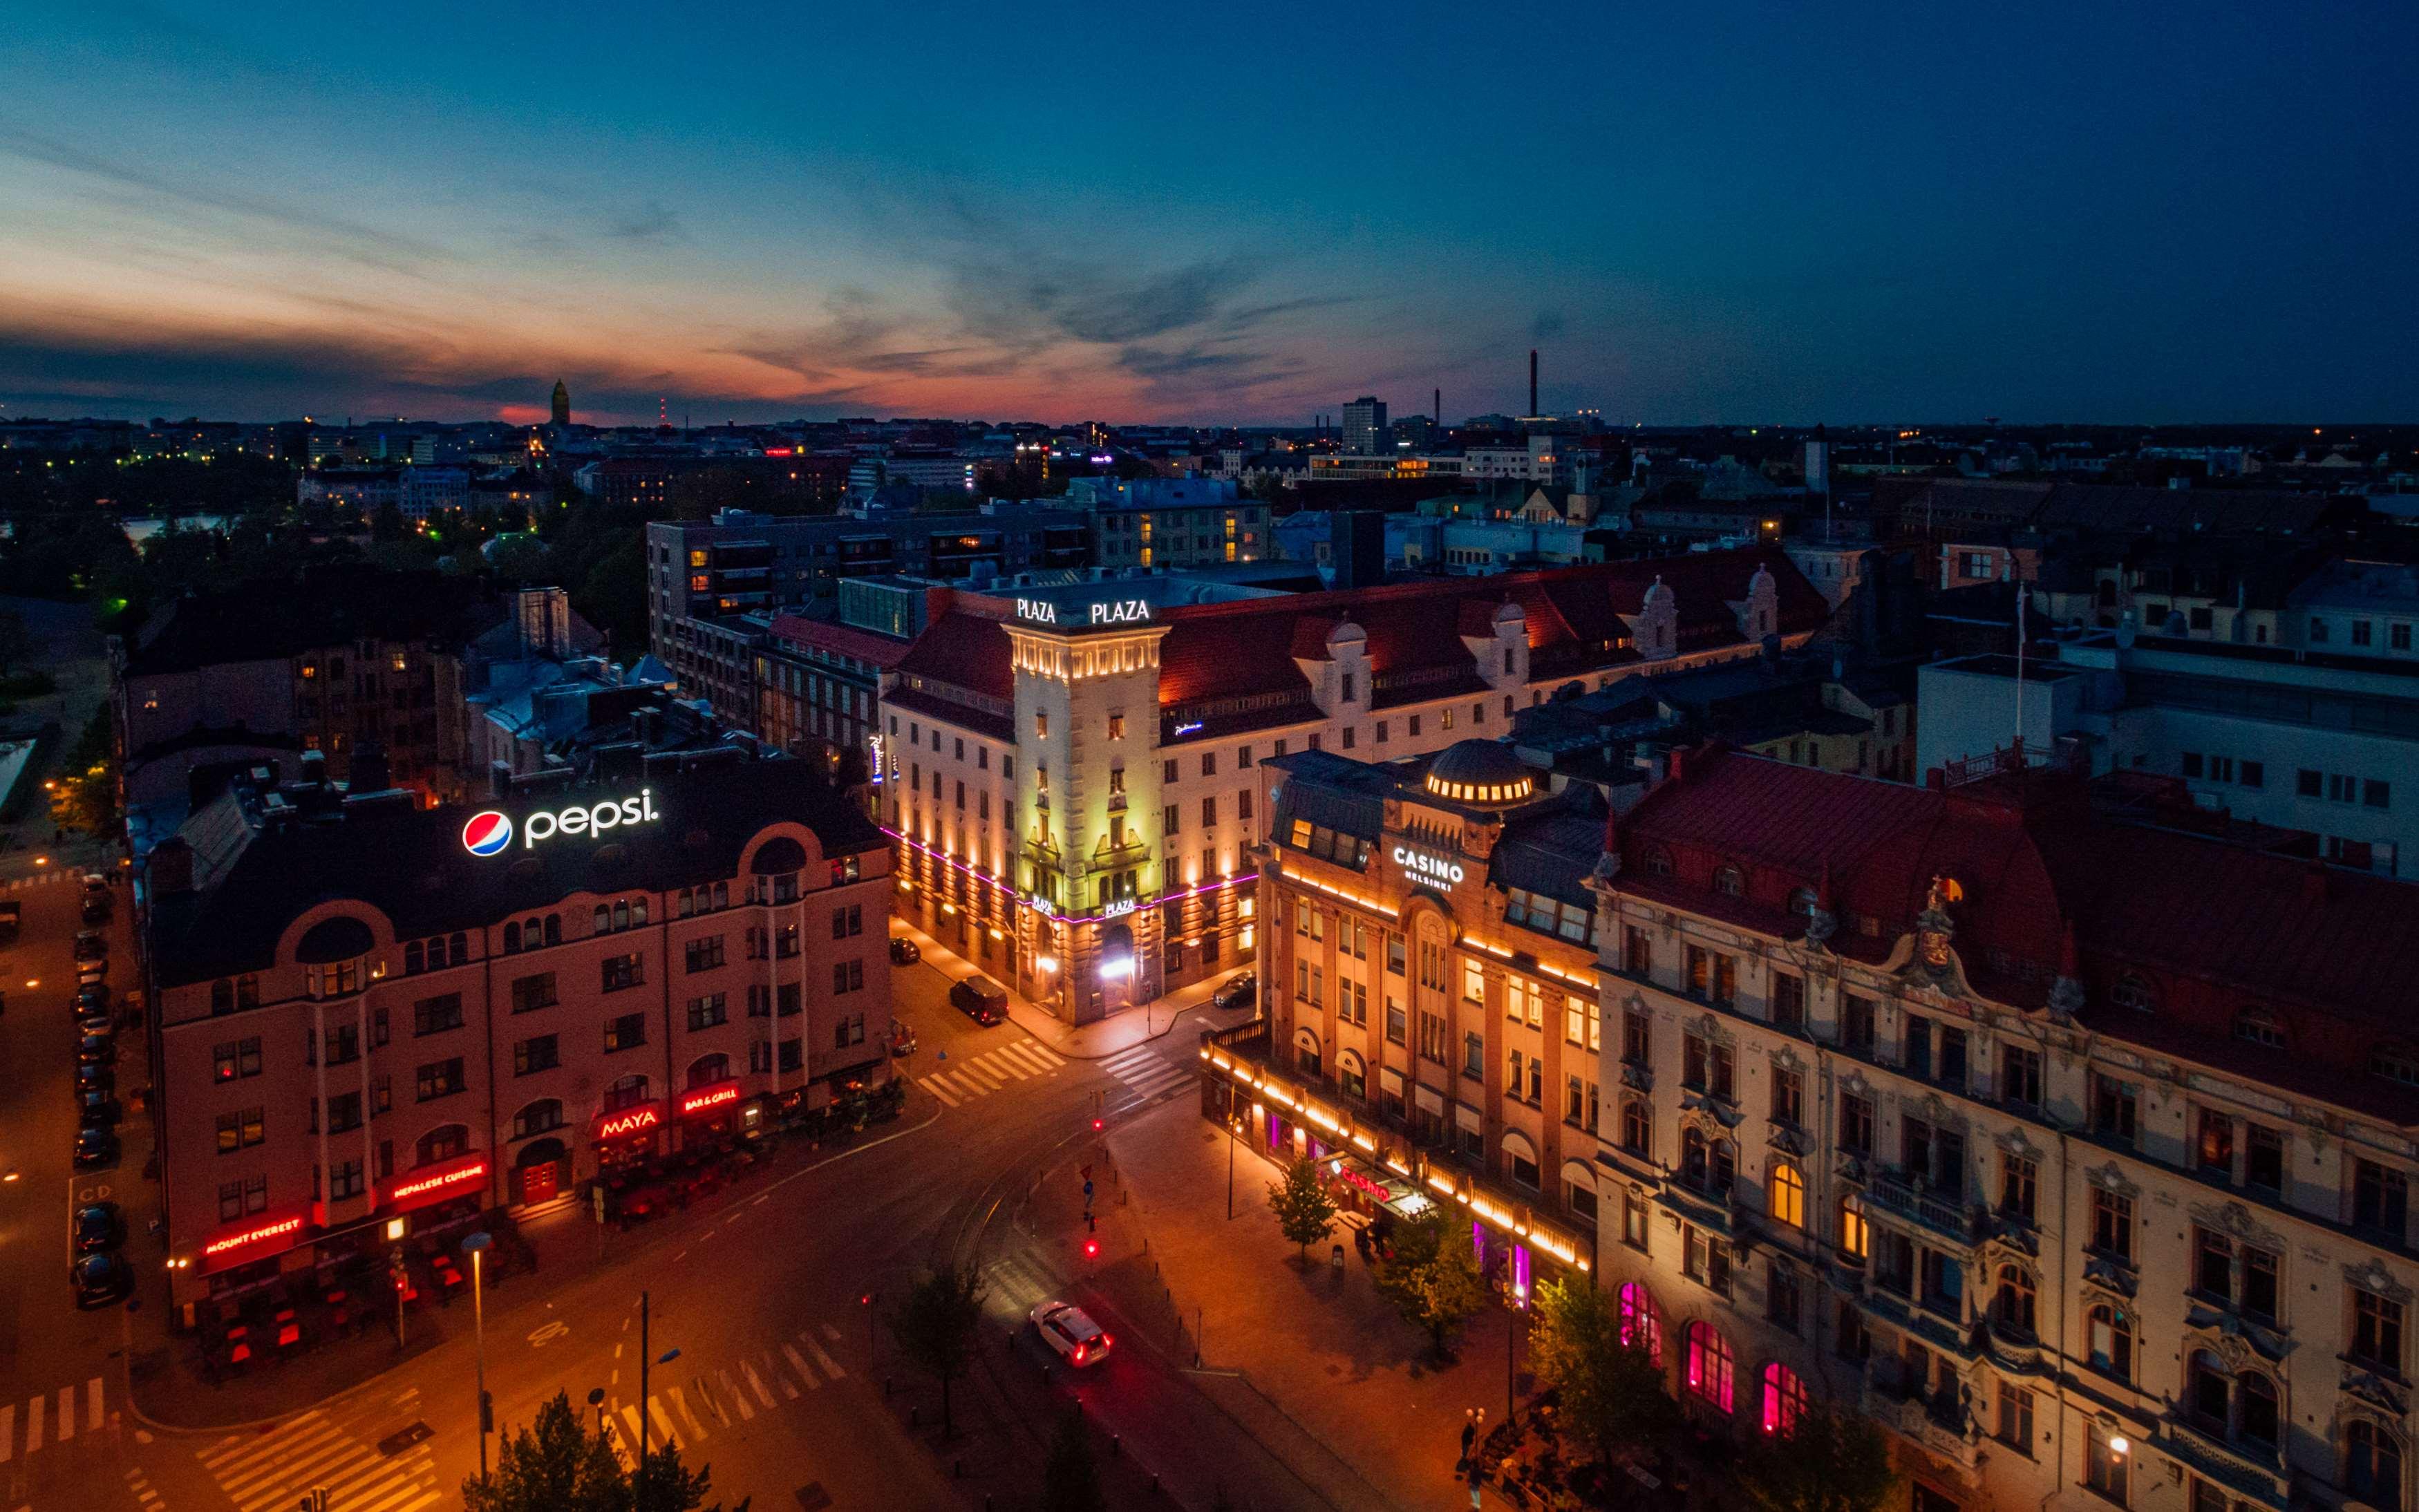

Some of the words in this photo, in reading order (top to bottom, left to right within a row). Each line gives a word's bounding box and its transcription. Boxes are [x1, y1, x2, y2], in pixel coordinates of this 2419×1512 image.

[1017, 598, 1056, 623] PLAZA
[1091, 599, 1150, 624] PLAZA
[1393, 847, 1464, 883] CASINO
[1404, 870, 1452, 893] HELSINKI
[1033, 895, 1053, 914] PLAZA
[1106, 898, 1135, 916] PLAZA
[685, 1099, 704, 1111] BAR
[704, 1096, 712, 1106] &
[711, 1089, 737, 1104] GRILL
[602, 1111, 656, 1138] MAYA
[79, 1184, 111, 1202] CD
[395, 1176, 443, 1198] NEPALESE
[444, 1165, 482, 1183] CUISINE
[1342, 1167, 1391, 1203] CASINO
[206, 1234, 250, 1254] MOUNT
[251, 1218, 300, 1240] EVEREST
